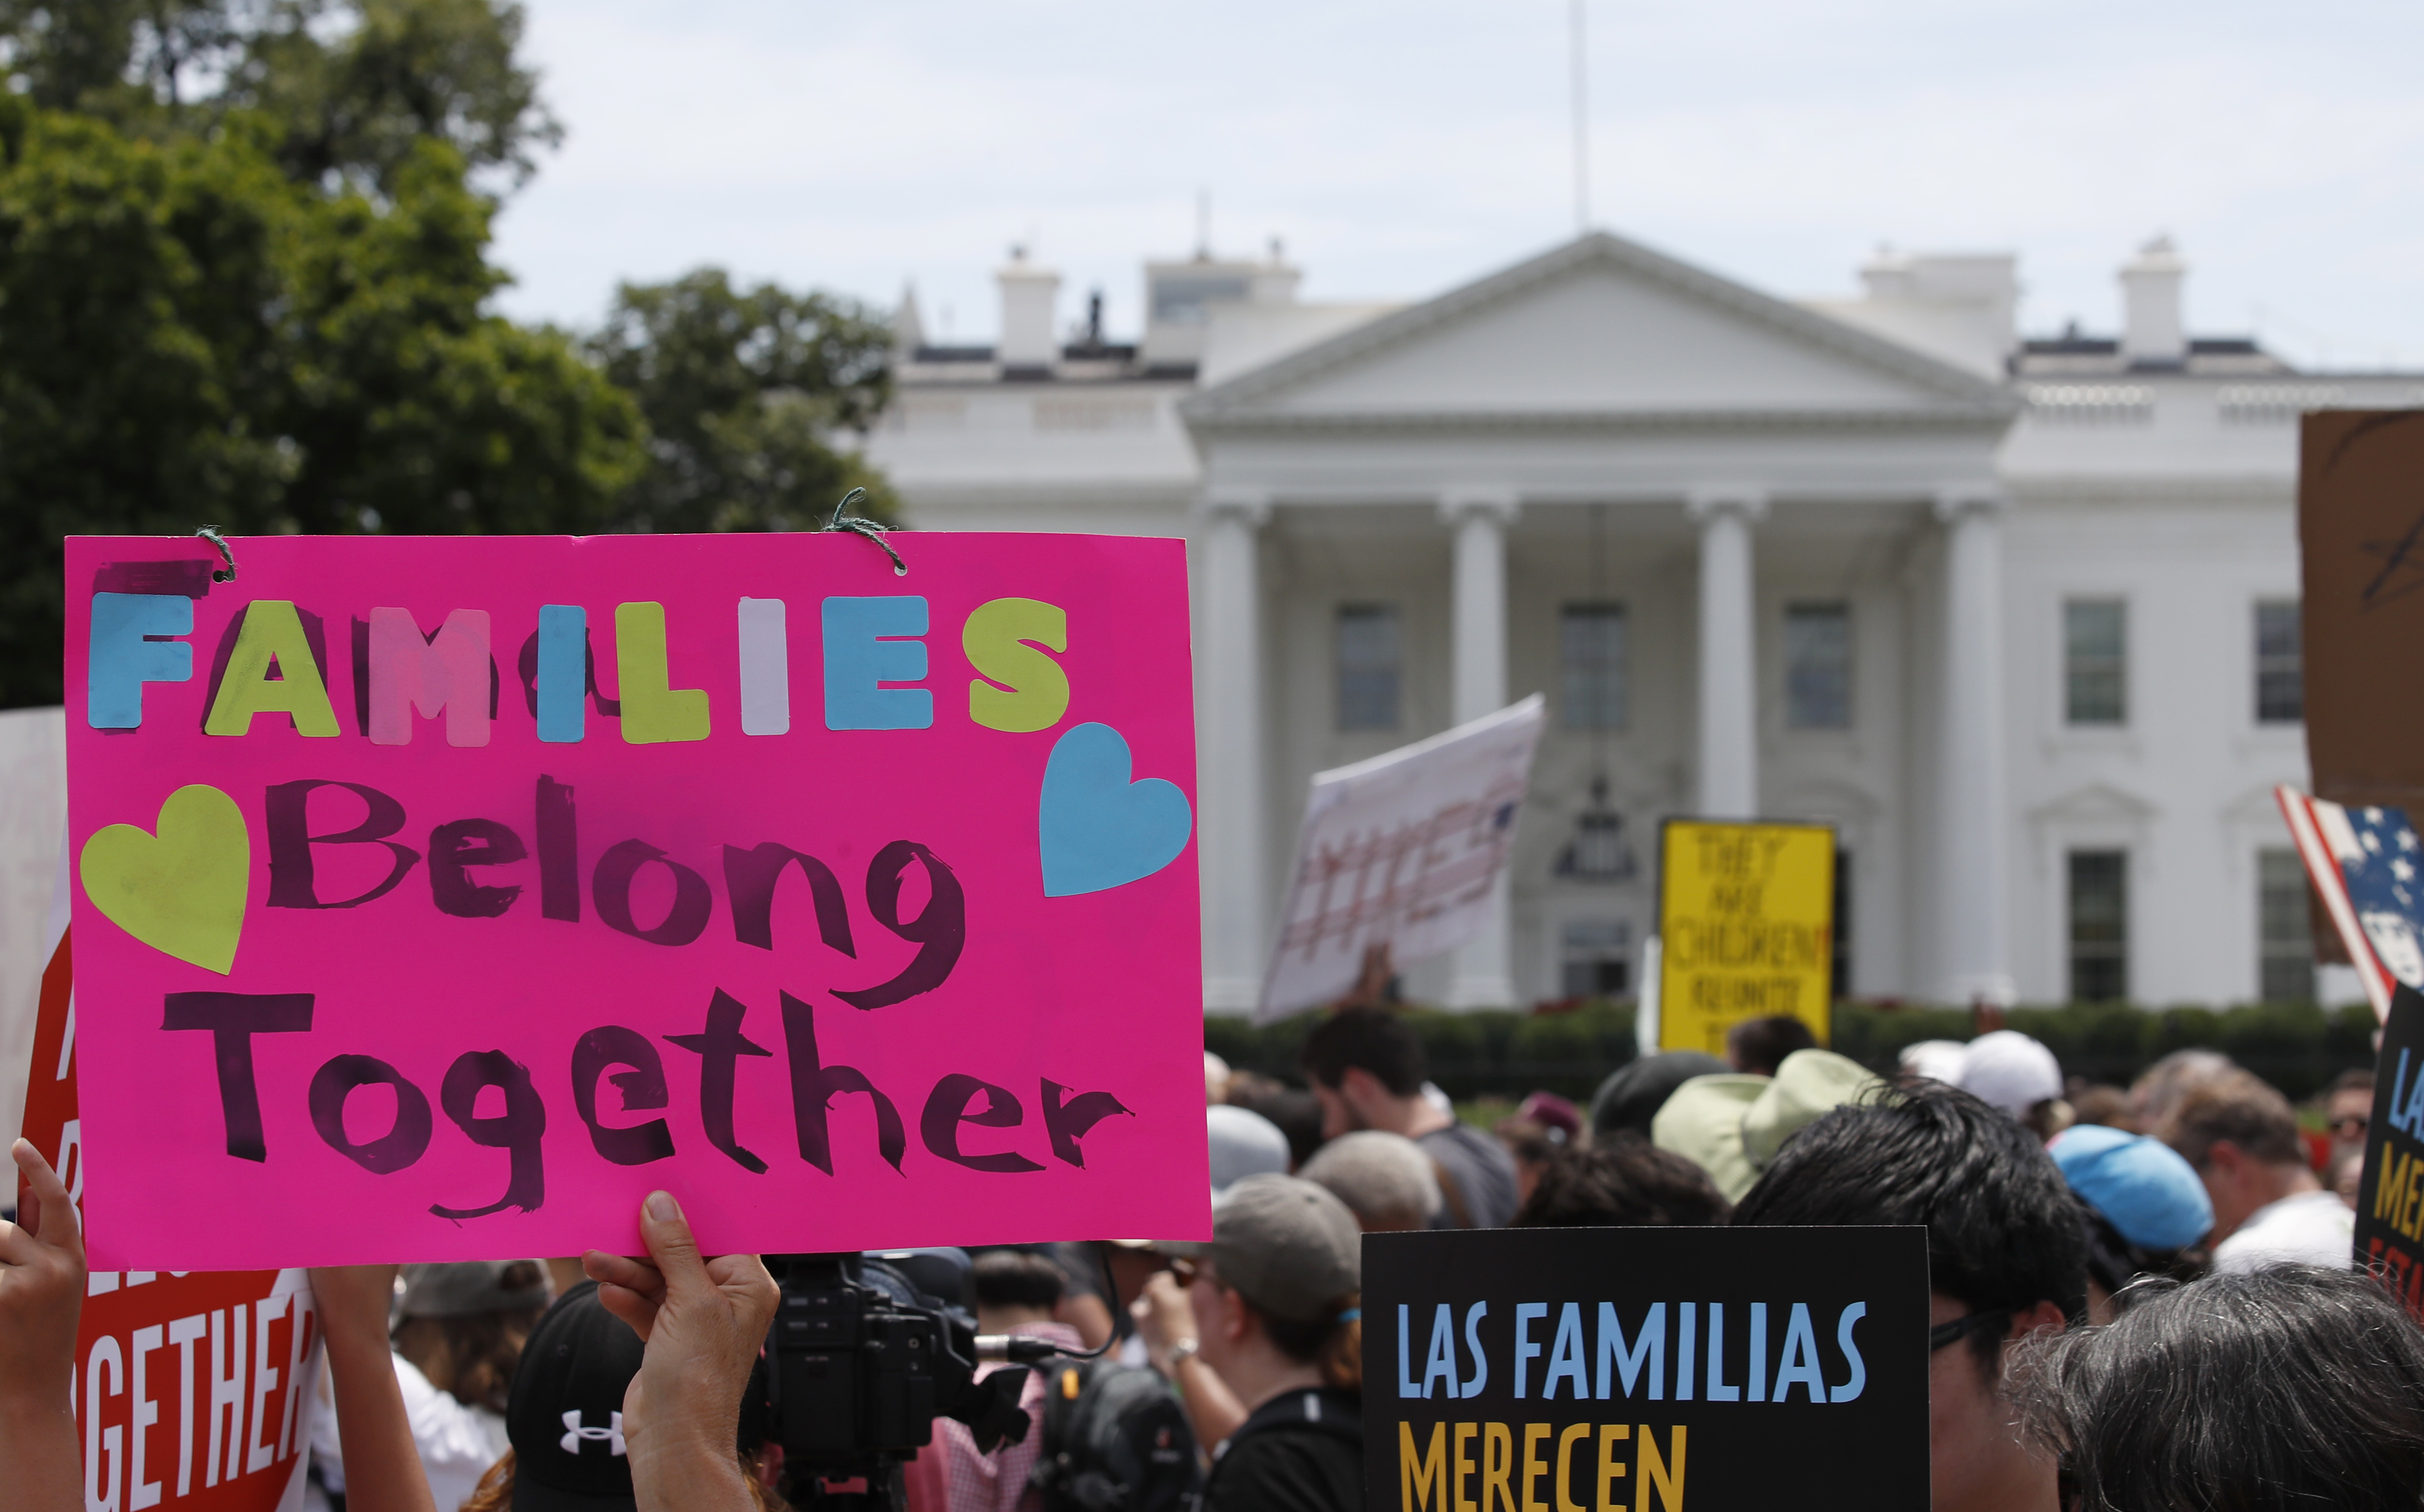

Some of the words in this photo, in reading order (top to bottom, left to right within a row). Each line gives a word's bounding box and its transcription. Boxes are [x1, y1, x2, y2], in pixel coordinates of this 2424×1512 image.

[88, 592, 1070, 747] FAMILIES
[266, 774, 965, 1011] Belong
[159, 987, 1137, 1228] Together
[2387, 1046, 2424, 1145] LA
[70, 1289, 321, 1512] GETHER
[1398, 1300, 1487, 1399] LAS
[1514, 1301, 1866, 1404] FAMILIAS
[1399, 1420, 1687, 1512] MERECEN
